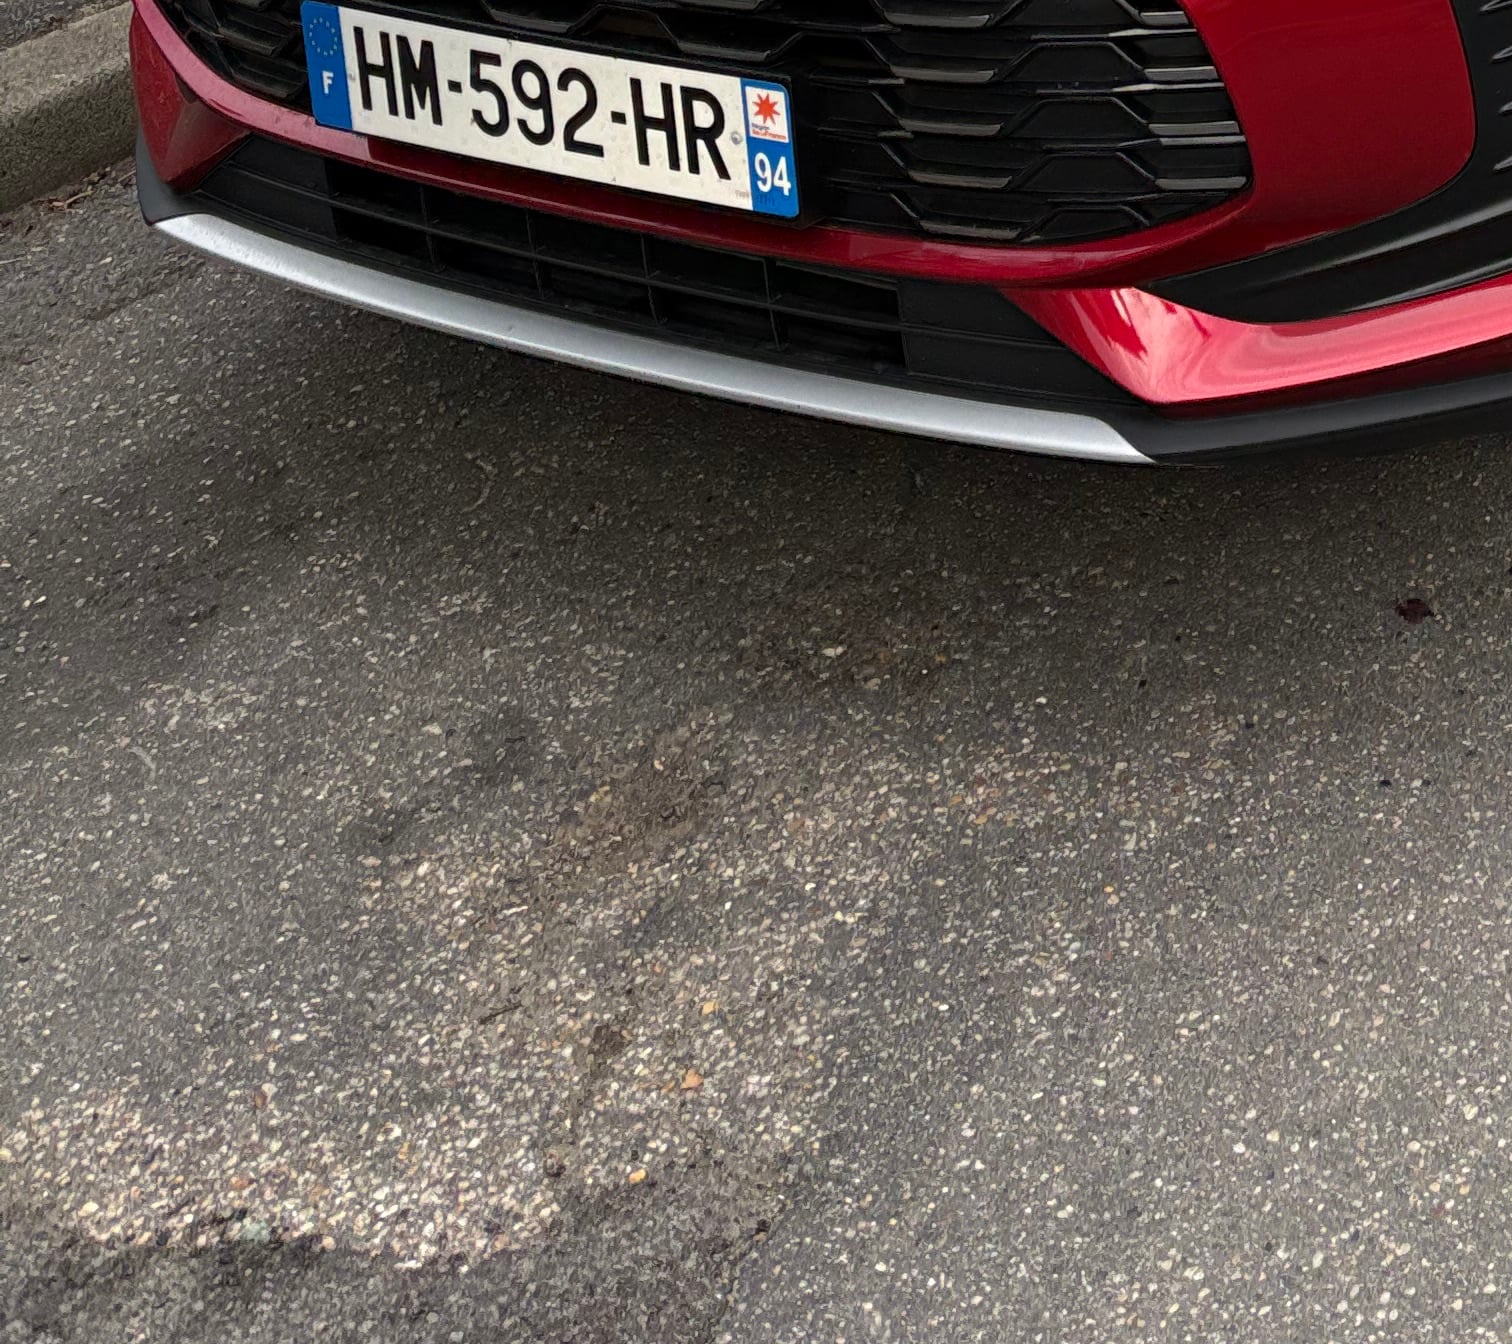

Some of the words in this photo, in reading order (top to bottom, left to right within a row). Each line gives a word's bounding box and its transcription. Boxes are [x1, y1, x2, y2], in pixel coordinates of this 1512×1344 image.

[322, 70, 334, 95] F
[353, 25, 732, 181] HM-592-HR
[754, 152, 792, 197] 94
